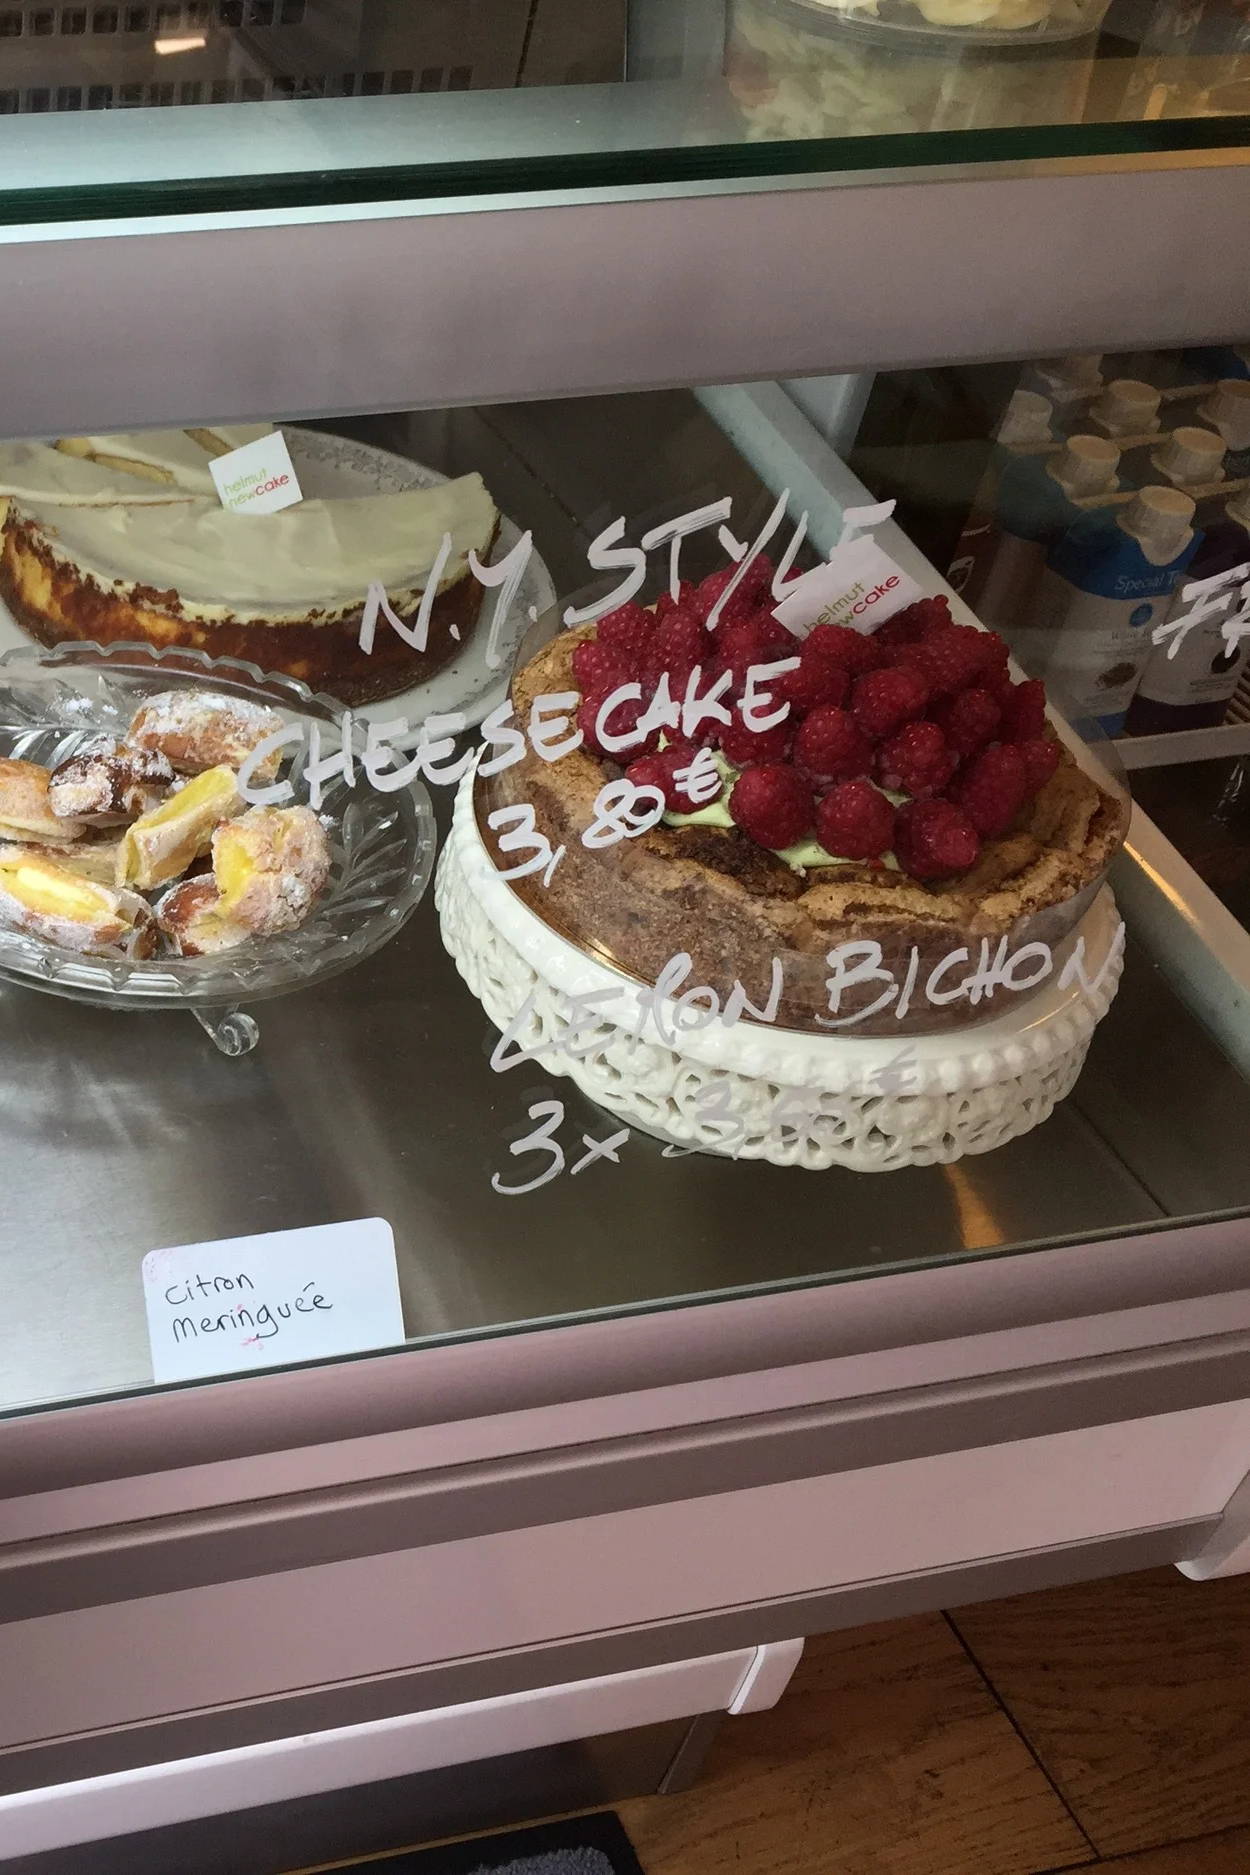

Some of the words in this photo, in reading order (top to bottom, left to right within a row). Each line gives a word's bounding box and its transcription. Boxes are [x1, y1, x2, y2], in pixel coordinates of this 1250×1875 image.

[222, 467, 268, 497] helmut
[563, 487, 898, 630] STYLE
[802, 580, 866, 632] helmut
[814, 921, 1126, 1028] BICHON
